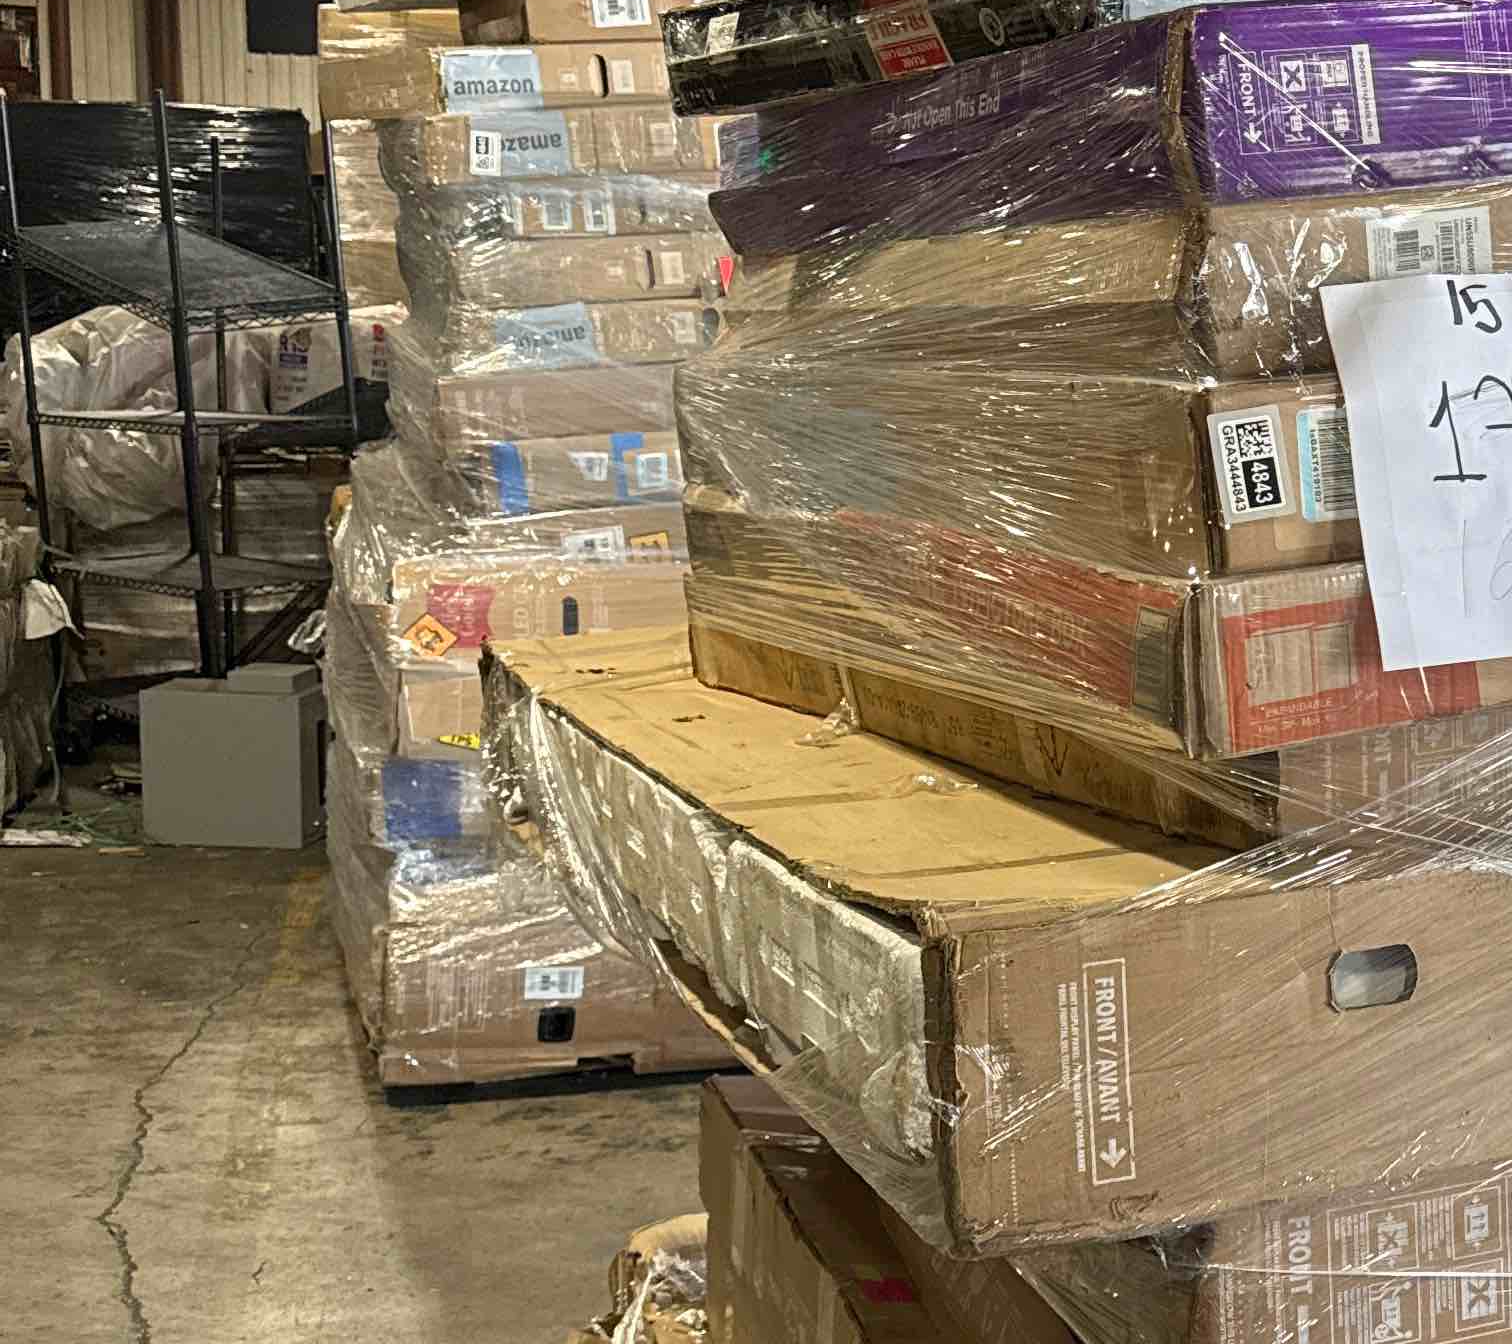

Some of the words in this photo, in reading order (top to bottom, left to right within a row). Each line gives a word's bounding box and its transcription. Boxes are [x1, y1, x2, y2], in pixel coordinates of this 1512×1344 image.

[453, 77, 535, 96] amazon
[954, 96, 976, 121] This
[977, 92, 1000, 116] End
[1238, 63, 1257, 116] FRONT
[501, 133, 563, 153] amaz
[1447, 279, 1502, 334] 15
[1250, 460, 1274, 505] 4843
[1288, 1215, 1313, 1295] FRONT
